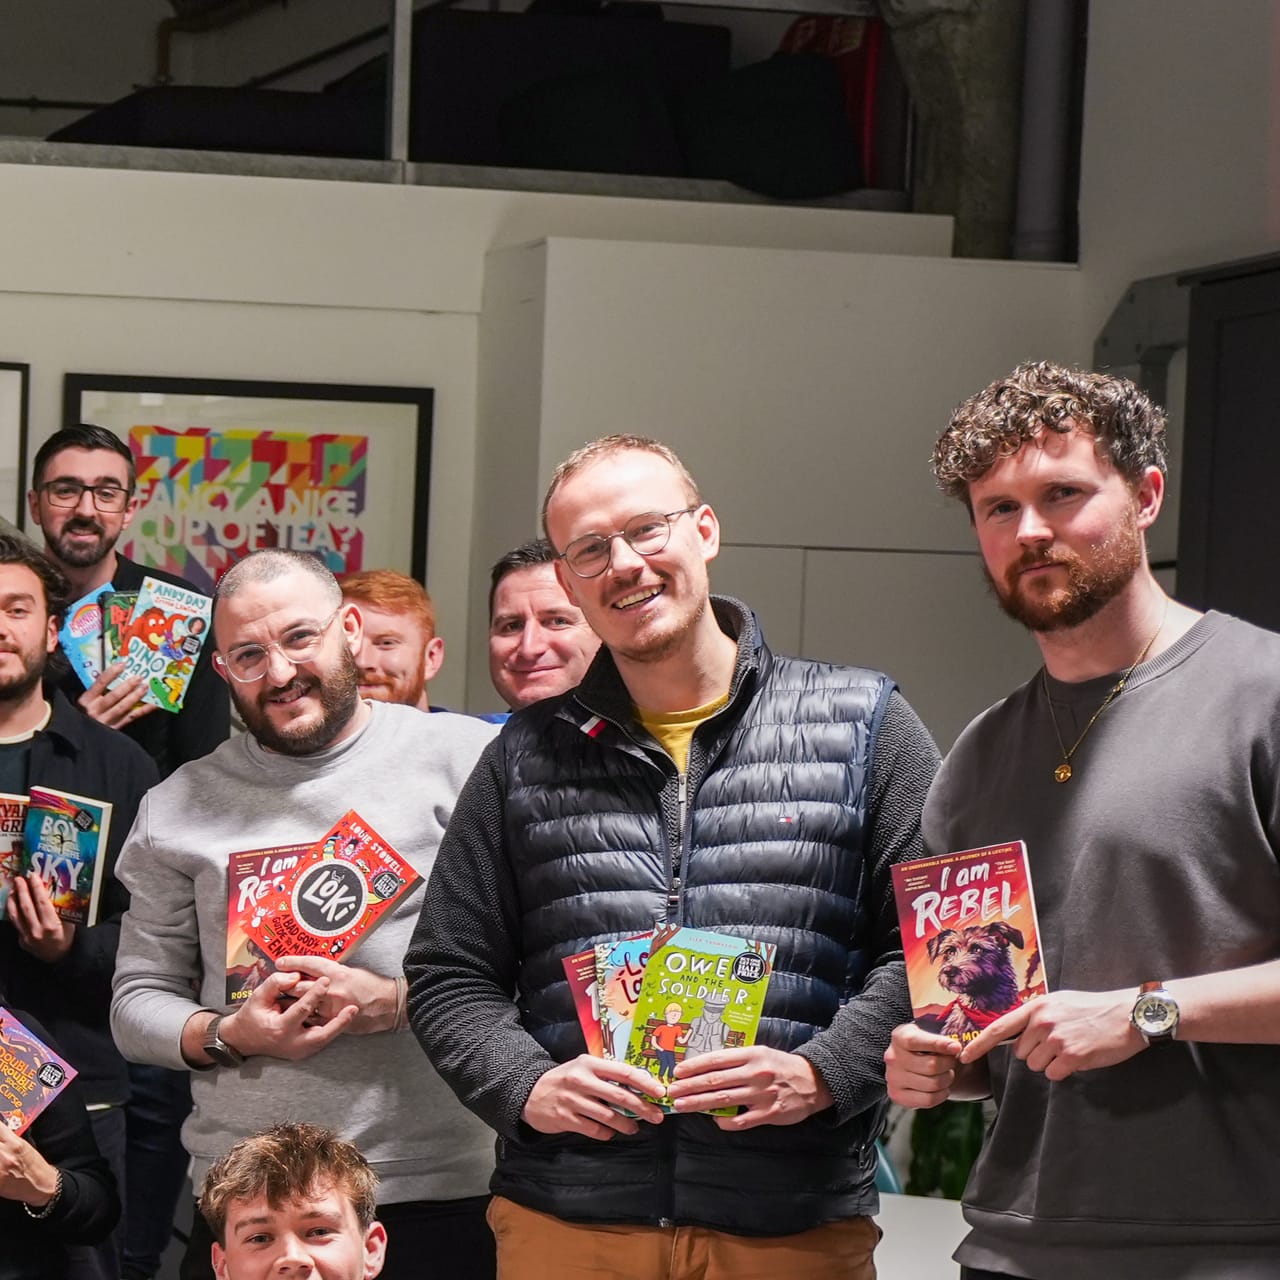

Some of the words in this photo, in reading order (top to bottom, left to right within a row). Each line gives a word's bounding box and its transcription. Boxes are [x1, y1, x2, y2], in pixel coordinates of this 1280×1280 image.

[138, 482, 237, 514] FANCY
[250, 486, 275, 514] A
[283, 488, 357, 514] NICE
[217, 518, 270, 550] OF
[275, 521, 361, 551] TEA?
[130, 639, 165, 673] DINO
[349, 822, 372, 845] LOUIE
[370, 842, 404, 876] STOWELL
[31, 852, 84, 890] SKY
[941, 866, 950, 891] I
[956, 862, 990, 888] am
[658, 978, 749, 1004] SOLDIER
[680, 974, 699, 983] AND
[705, 977, 724, 988] THE
